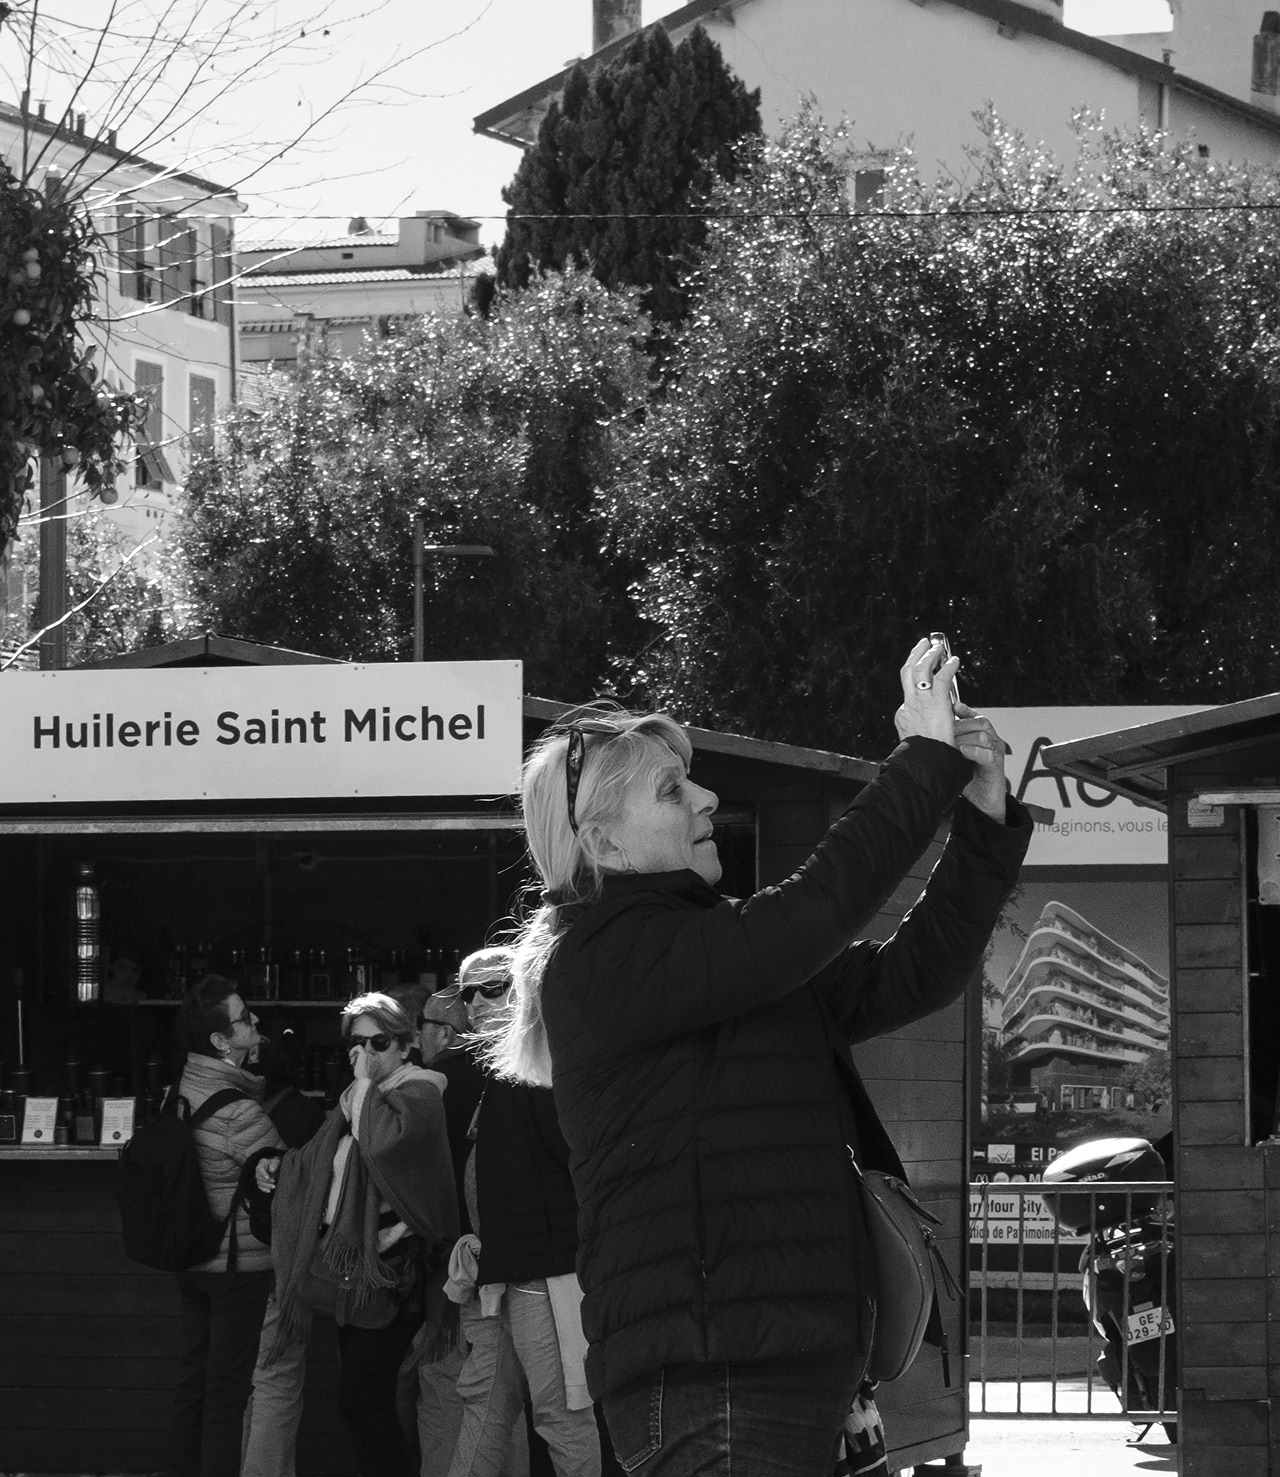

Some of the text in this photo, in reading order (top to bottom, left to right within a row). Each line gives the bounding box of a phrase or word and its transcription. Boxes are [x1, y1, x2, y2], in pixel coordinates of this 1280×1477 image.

[33, 704, 486, 750] Huilerie Saint Michel
[1118, 821, 1154, 833] vous
[1031, 1147, 1043, 1161] El
[993, 1226, 1004, 1239] de
